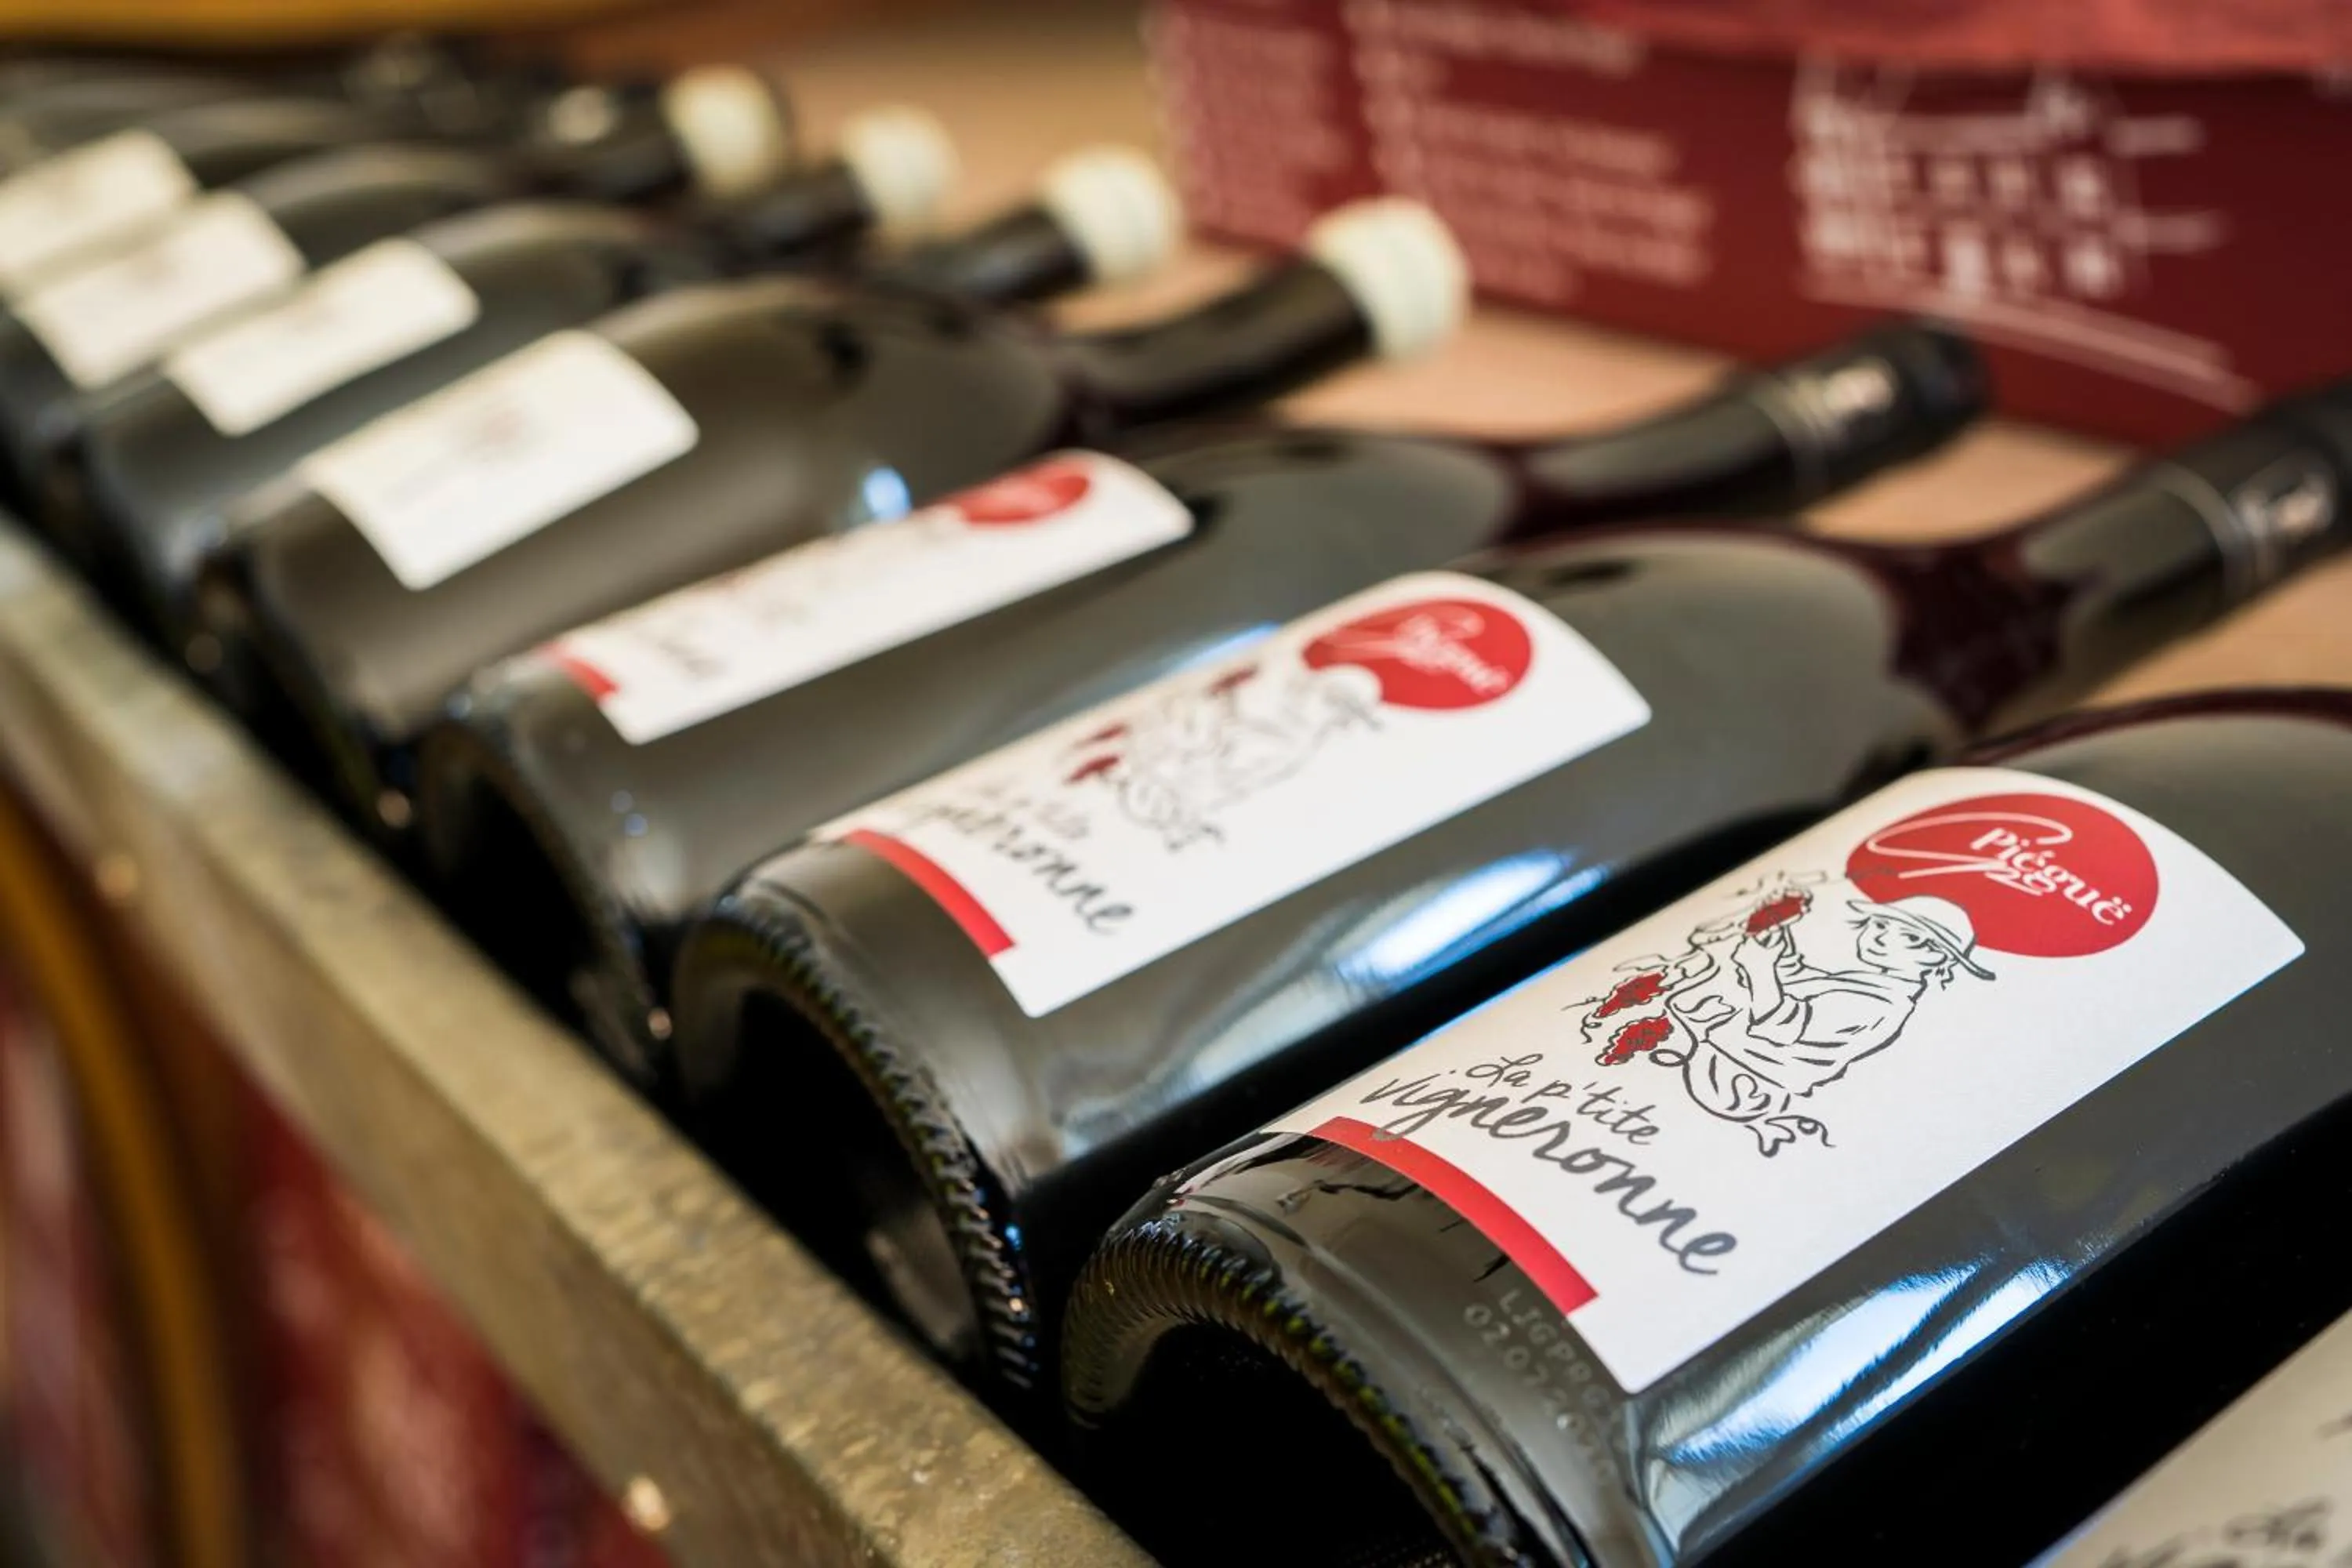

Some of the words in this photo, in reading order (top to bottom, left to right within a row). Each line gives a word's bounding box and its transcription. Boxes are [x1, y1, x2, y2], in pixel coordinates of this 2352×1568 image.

[1359, 1069, 1737, 1276] vigneronne
[1465, 1053, 1543, 1089] La
[1521, 1080, 1661, 1145] p'tite
